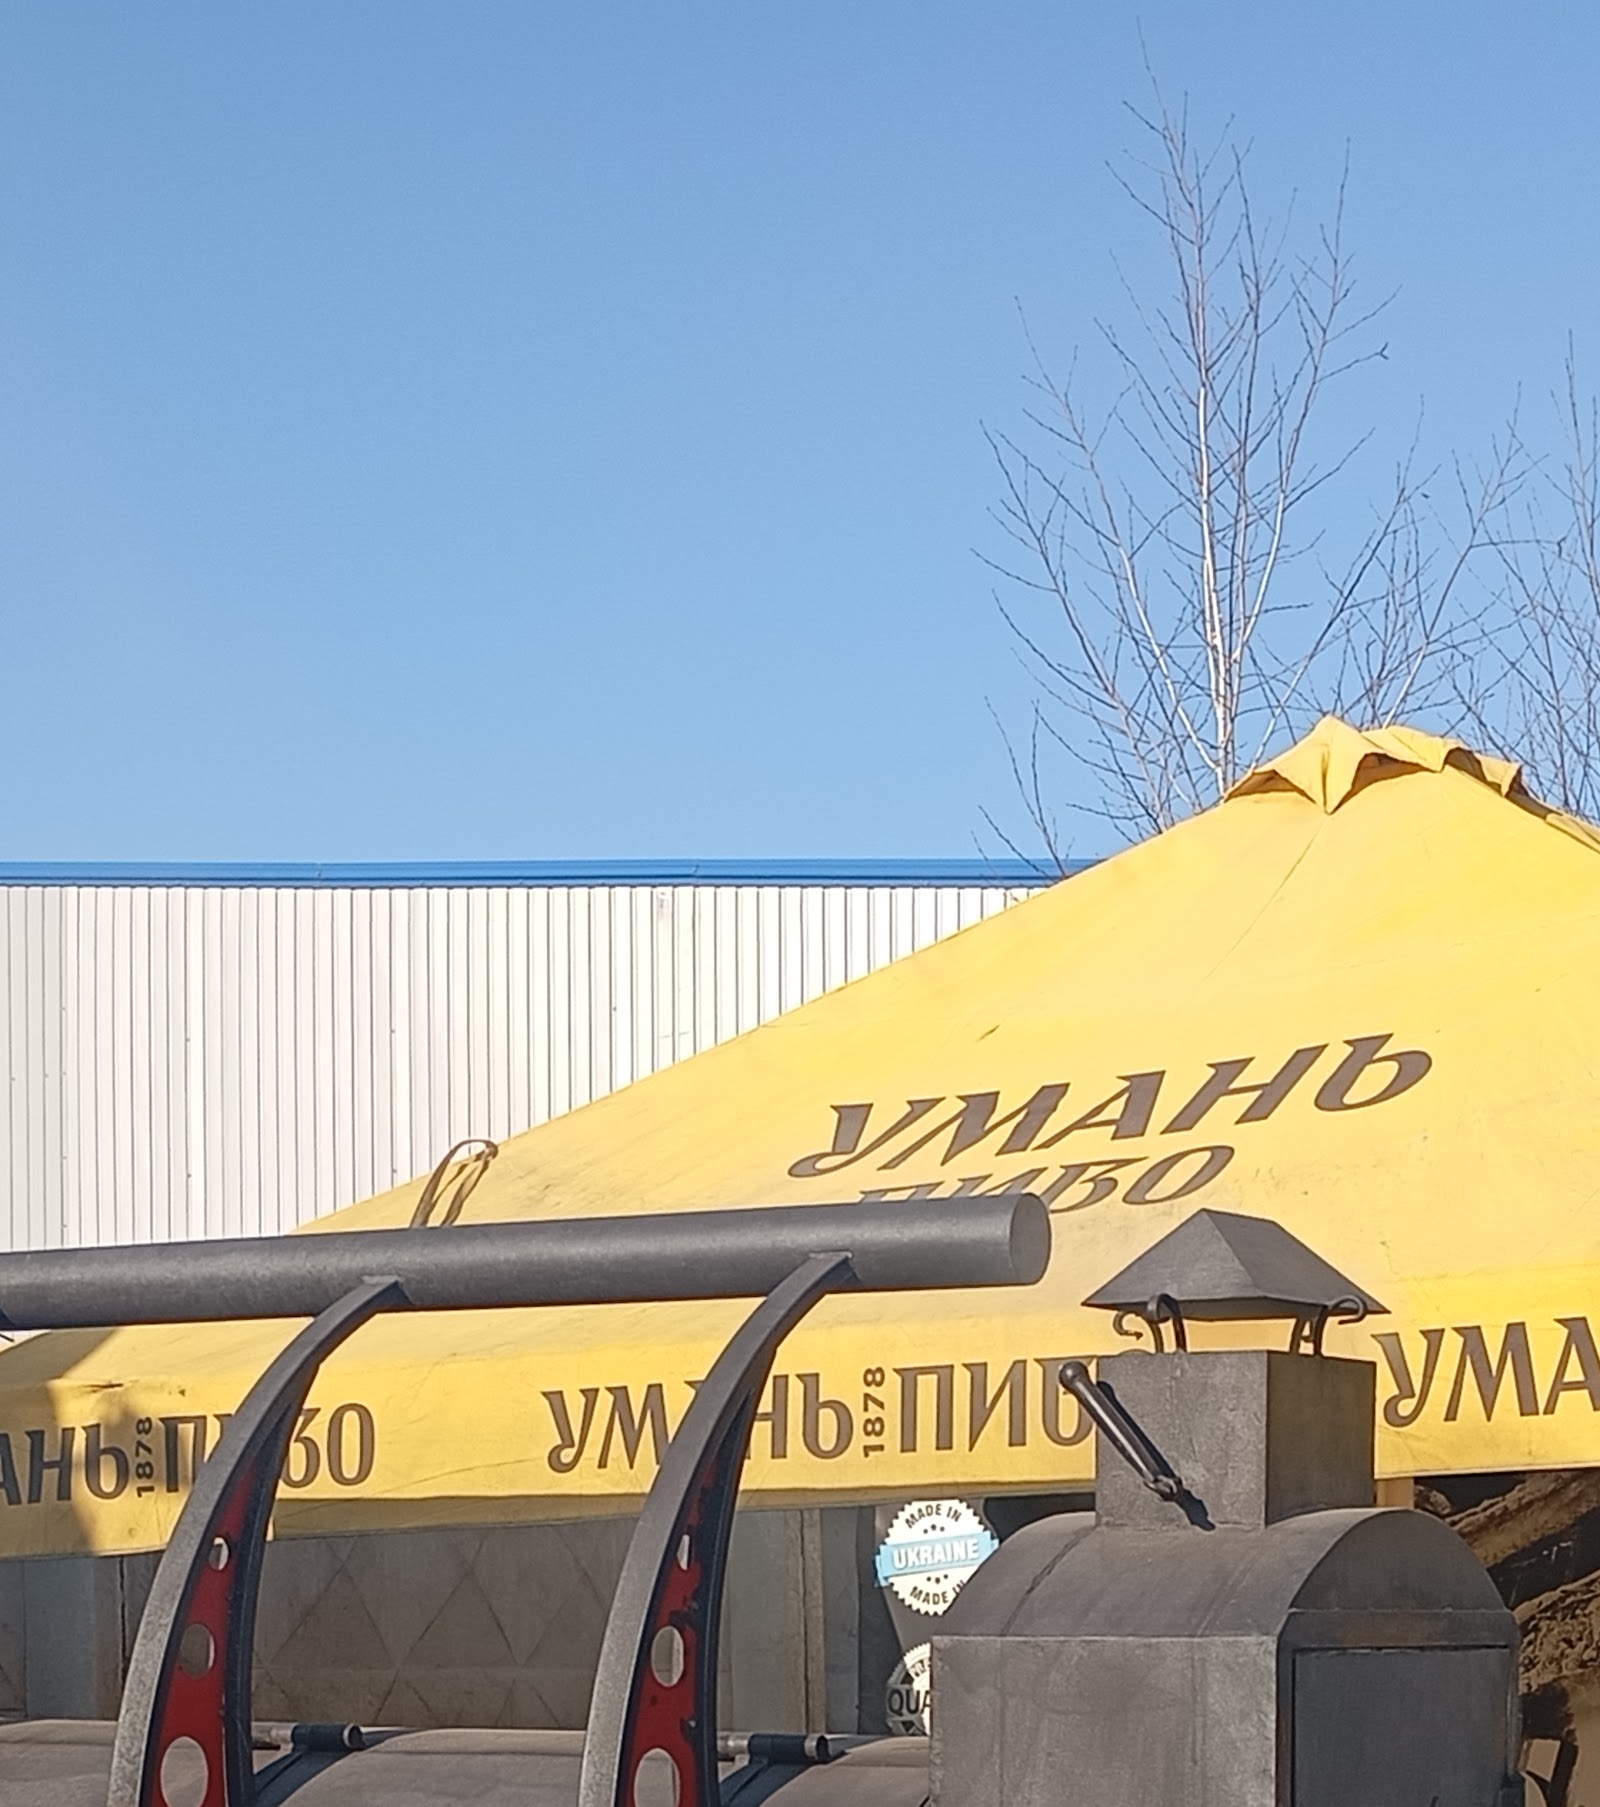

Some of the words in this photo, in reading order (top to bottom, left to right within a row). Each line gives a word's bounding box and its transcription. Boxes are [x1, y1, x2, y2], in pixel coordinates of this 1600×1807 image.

[787, 1032, 1432, 1178] УМАНЬ
[863, 1366, 886, 1458] 1878
[135, 1416, 155, 1498] 1878
[905, 1503, 942, 1528] MADE
[947, 1506, 962, 1522] IN
[893, 1538, 979, 1569] UKRAINE
[909, 1586, 949, 1605] MADE
